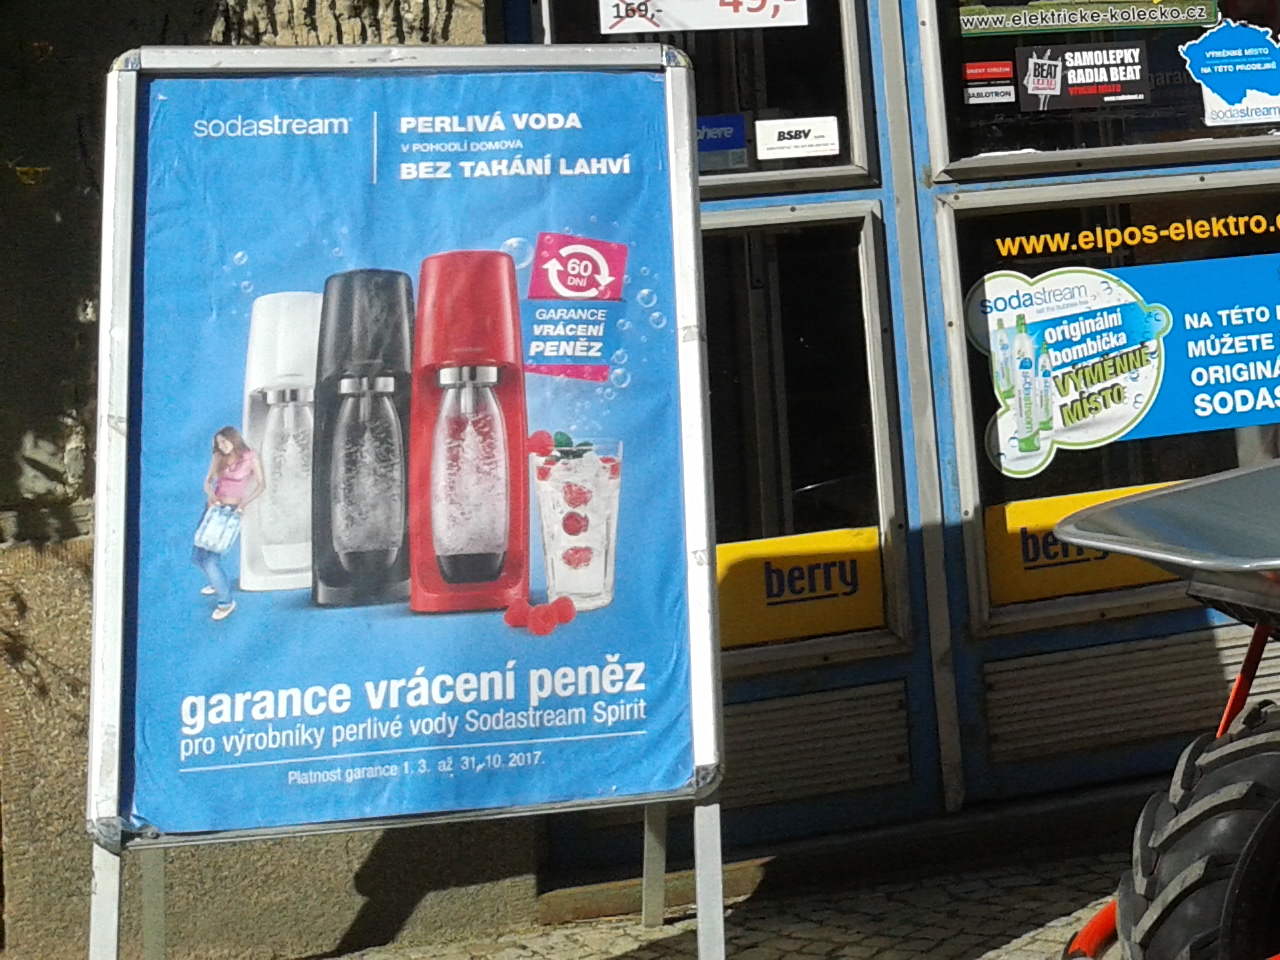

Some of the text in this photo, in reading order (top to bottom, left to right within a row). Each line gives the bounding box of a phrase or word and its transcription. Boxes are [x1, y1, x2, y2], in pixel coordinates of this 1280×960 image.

[961, 5, 1206, 29] www.elektricke-kolecko.cz
[1064, 48, 1141, 67] SAMOLEPKY
[1033, 62, 1058, 78] BEAT
[1067, 67, 1108, 84] RADIA
[1110, 65, 1141, 82] BEAT
[193, 110, 582, 139] sodastream PERLIVÁ VODA
[777, 129, 812, 142] BSBV
[401, 139, 524, 153] V POHODLÍ DOMOVA
[400, 153, 631, 181] BEZ TAHÁNÍ LAHVÍ
[567, 258, 592, 277] 60
[567, 276, 587, 287] DNÍ
[980, 284, 1088, 315] sodastream
[535, 308, 608, 321] GARANCE
[1044, 308, 1123, 344] originální
[1185, 311, 1213, 330] NA
[1217, 301, 1270, 327] TÉTO
[533, 321, 605, 337] VRÁCENÍ
[529, 337, 604, 357] PENĚZ
[1048, 331, 1128, 367] bombička
[1188, 329, 1275, 358] MŮŽETE
[1059, 382, 1126, 428] MÍSTO
[763, 558, 859, 598] berry
[181, 652, 647, 736] garance vrácení peněz
[179, 696, 647, 762] pro výrobníky perlivé vody Sodastream Spirit
[288, 766, 342, 786] Platnost
[344, 764, 398, 783] garance
